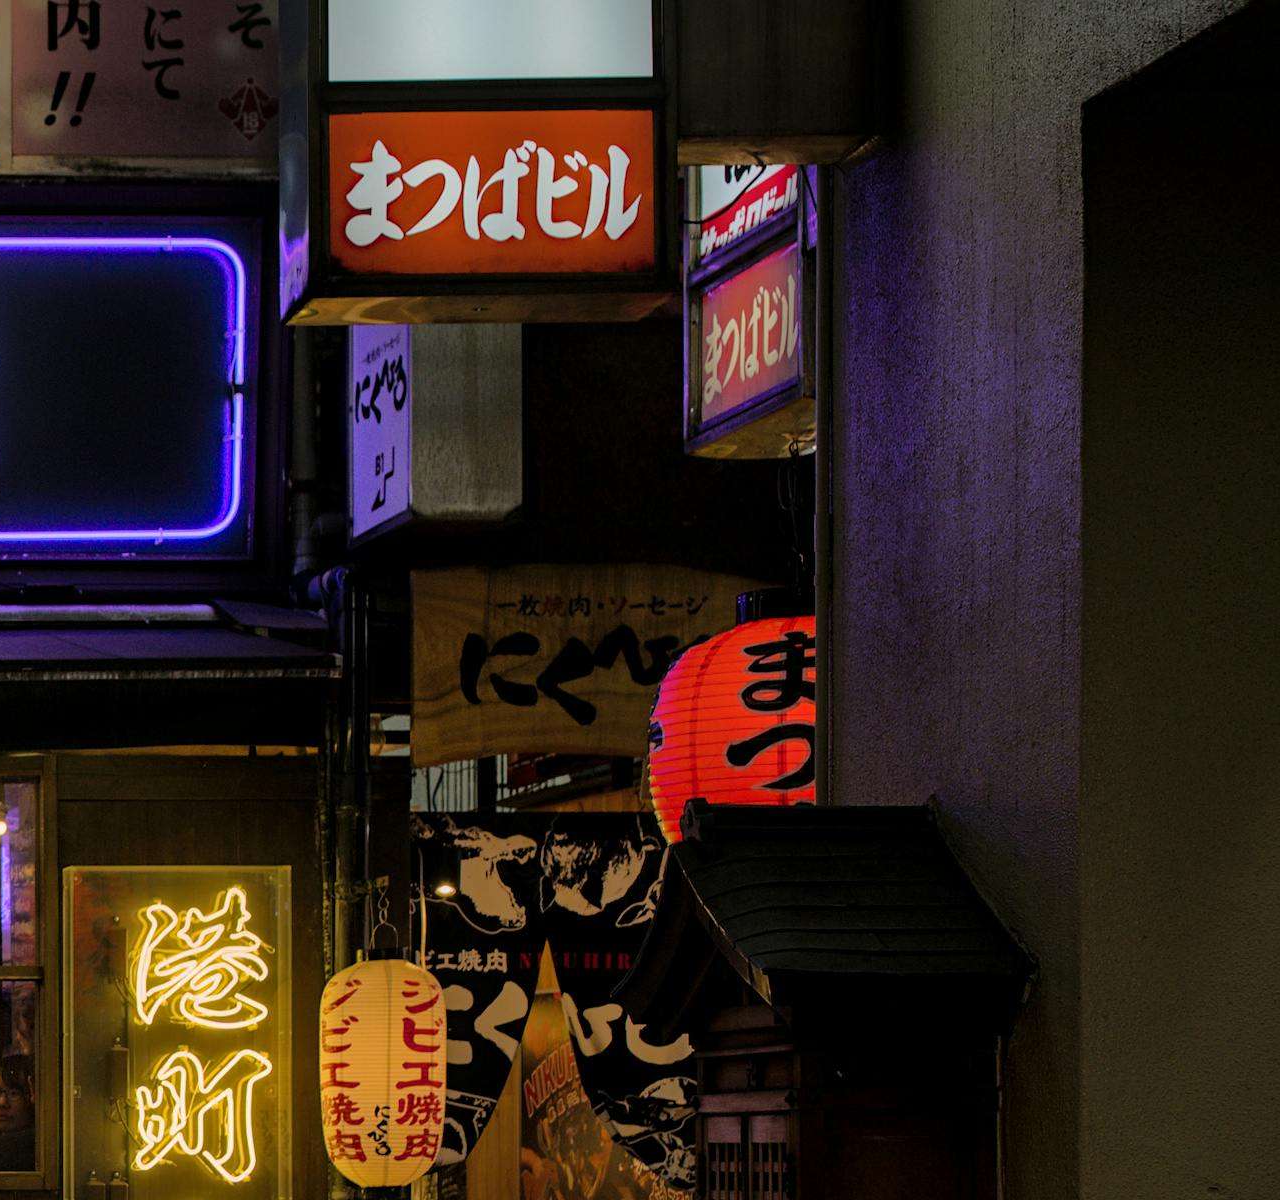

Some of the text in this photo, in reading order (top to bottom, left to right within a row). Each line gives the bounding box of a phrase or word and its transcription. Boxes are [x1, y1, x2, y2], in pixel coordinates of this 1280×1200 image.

[344, 139, 641, 248] まつばビル
[701, 172, 799, 258] サッポロビール
[704, 274, 799, 403] まつばビル
[460, 624, 713, 726] にくひ
[394, 979, 444, 1162] ジビエ焼肉
